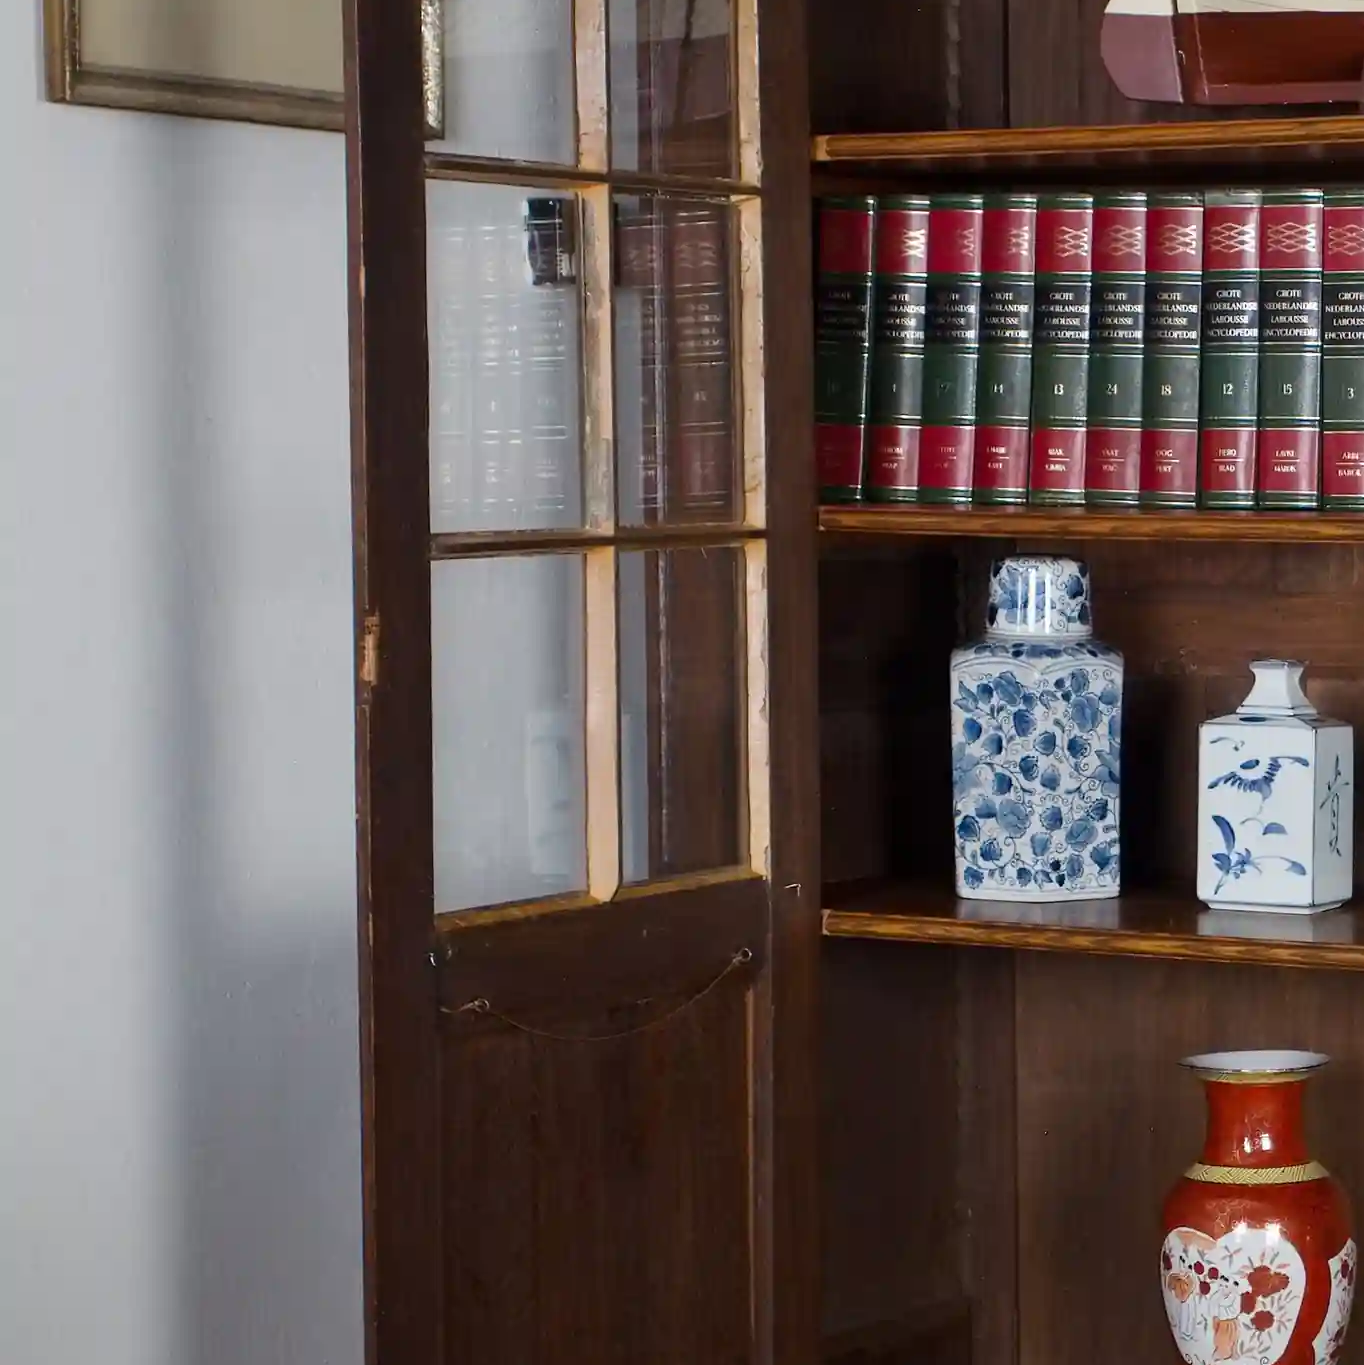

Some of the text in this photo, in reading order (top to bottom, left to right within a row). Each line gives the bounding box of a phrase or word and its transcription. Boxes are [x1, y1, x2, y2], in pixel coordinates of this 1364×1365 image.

[1049, 292, 1074, 301] GROTE
[1157, 292, 1182, 301] GROTE
[1216, 289, 1242, 298] GROTE
[1275, 289, 1302, 298] GROTE
[1338, 291, 1364, 300] GROTE
[1263, 301, 1318, 311] NEDERLANDSE
[1211, 315, 1249, 324] LAROUSSE
[1271, 315, 1309, 324] LAROUSSE
[1207, 328, 1259, 337] NCYCLOPEDIE
[1054, 384, 1064, 395] 13
[1106, 383, 1118, 395] 24
[1161, 384, 1172, 396] 18
[1223, 383, 1234, 395] 12
[1283, 383, 1292, 395] 15
[1347, 387, 1354, 399] 3
